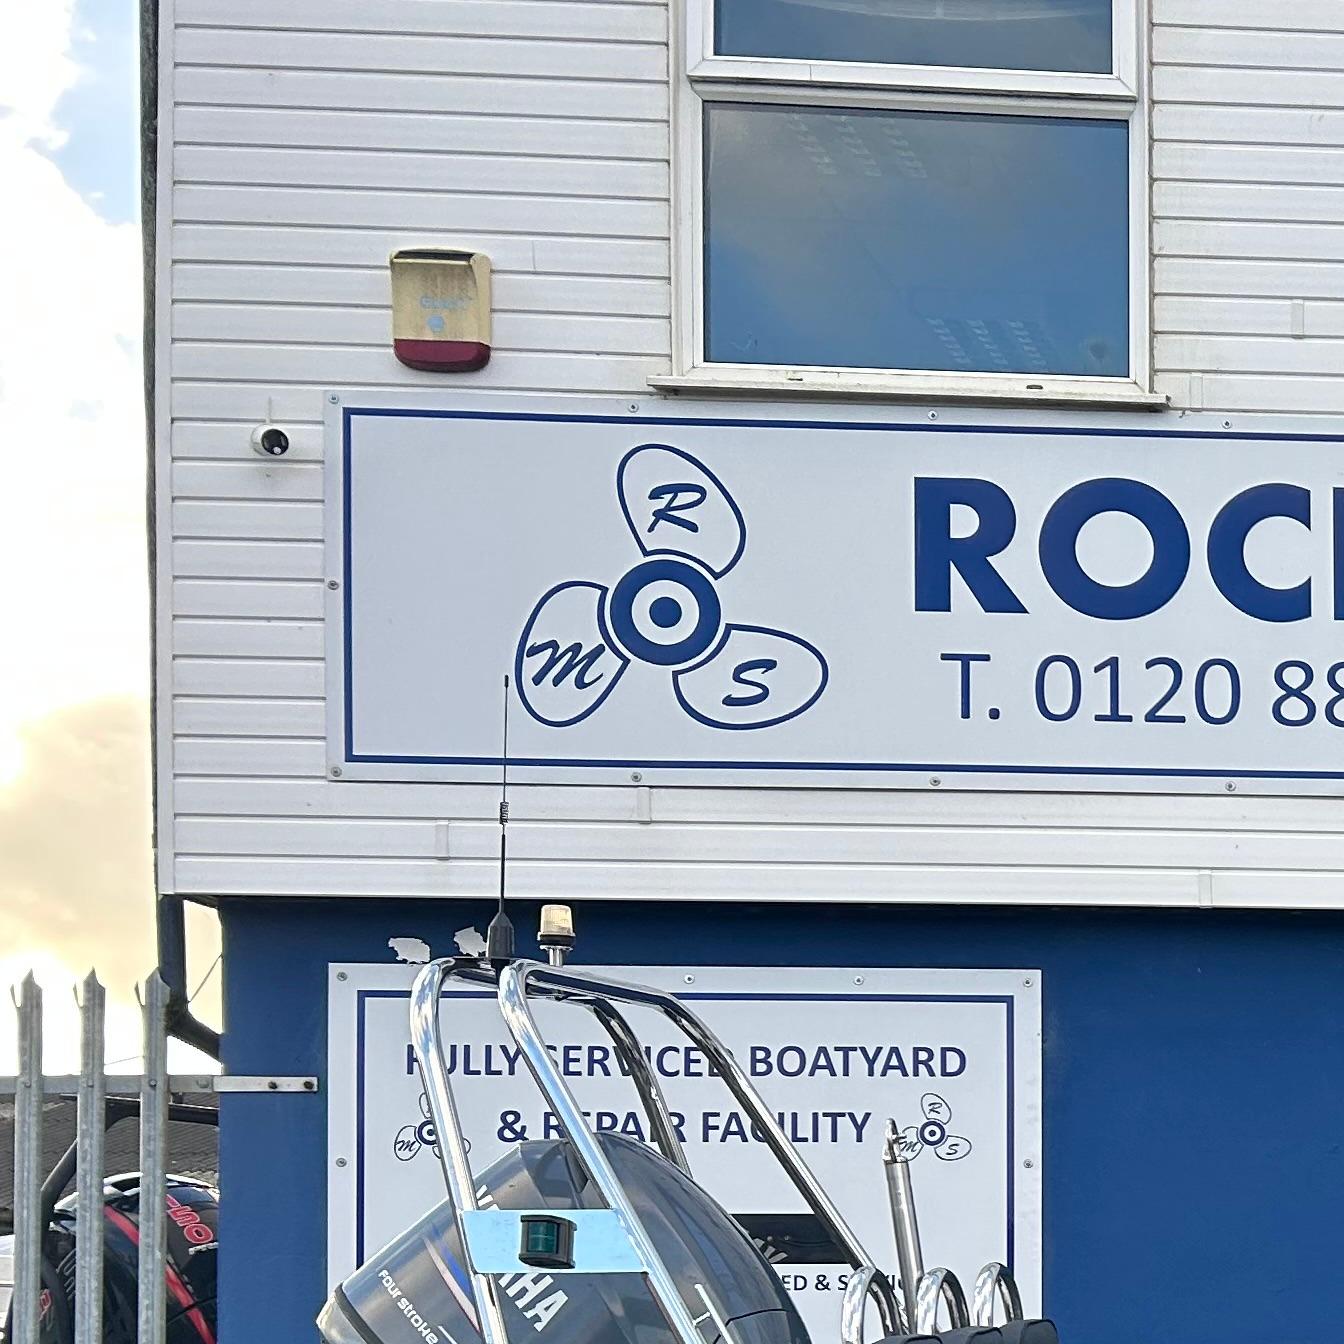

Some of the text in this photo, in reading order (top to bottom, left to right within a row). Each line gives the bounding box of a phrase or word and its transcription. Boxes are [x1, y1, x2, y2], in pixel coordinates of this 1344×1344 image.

[941, 653, 1000, 719] T.
[1035, 655, 1240, 725] 0120
[750, 1046, 967, 1078] BOATYARD
[497, 1110, 529, 1143] &
[543, 1112, 687, 1143] RPAR
